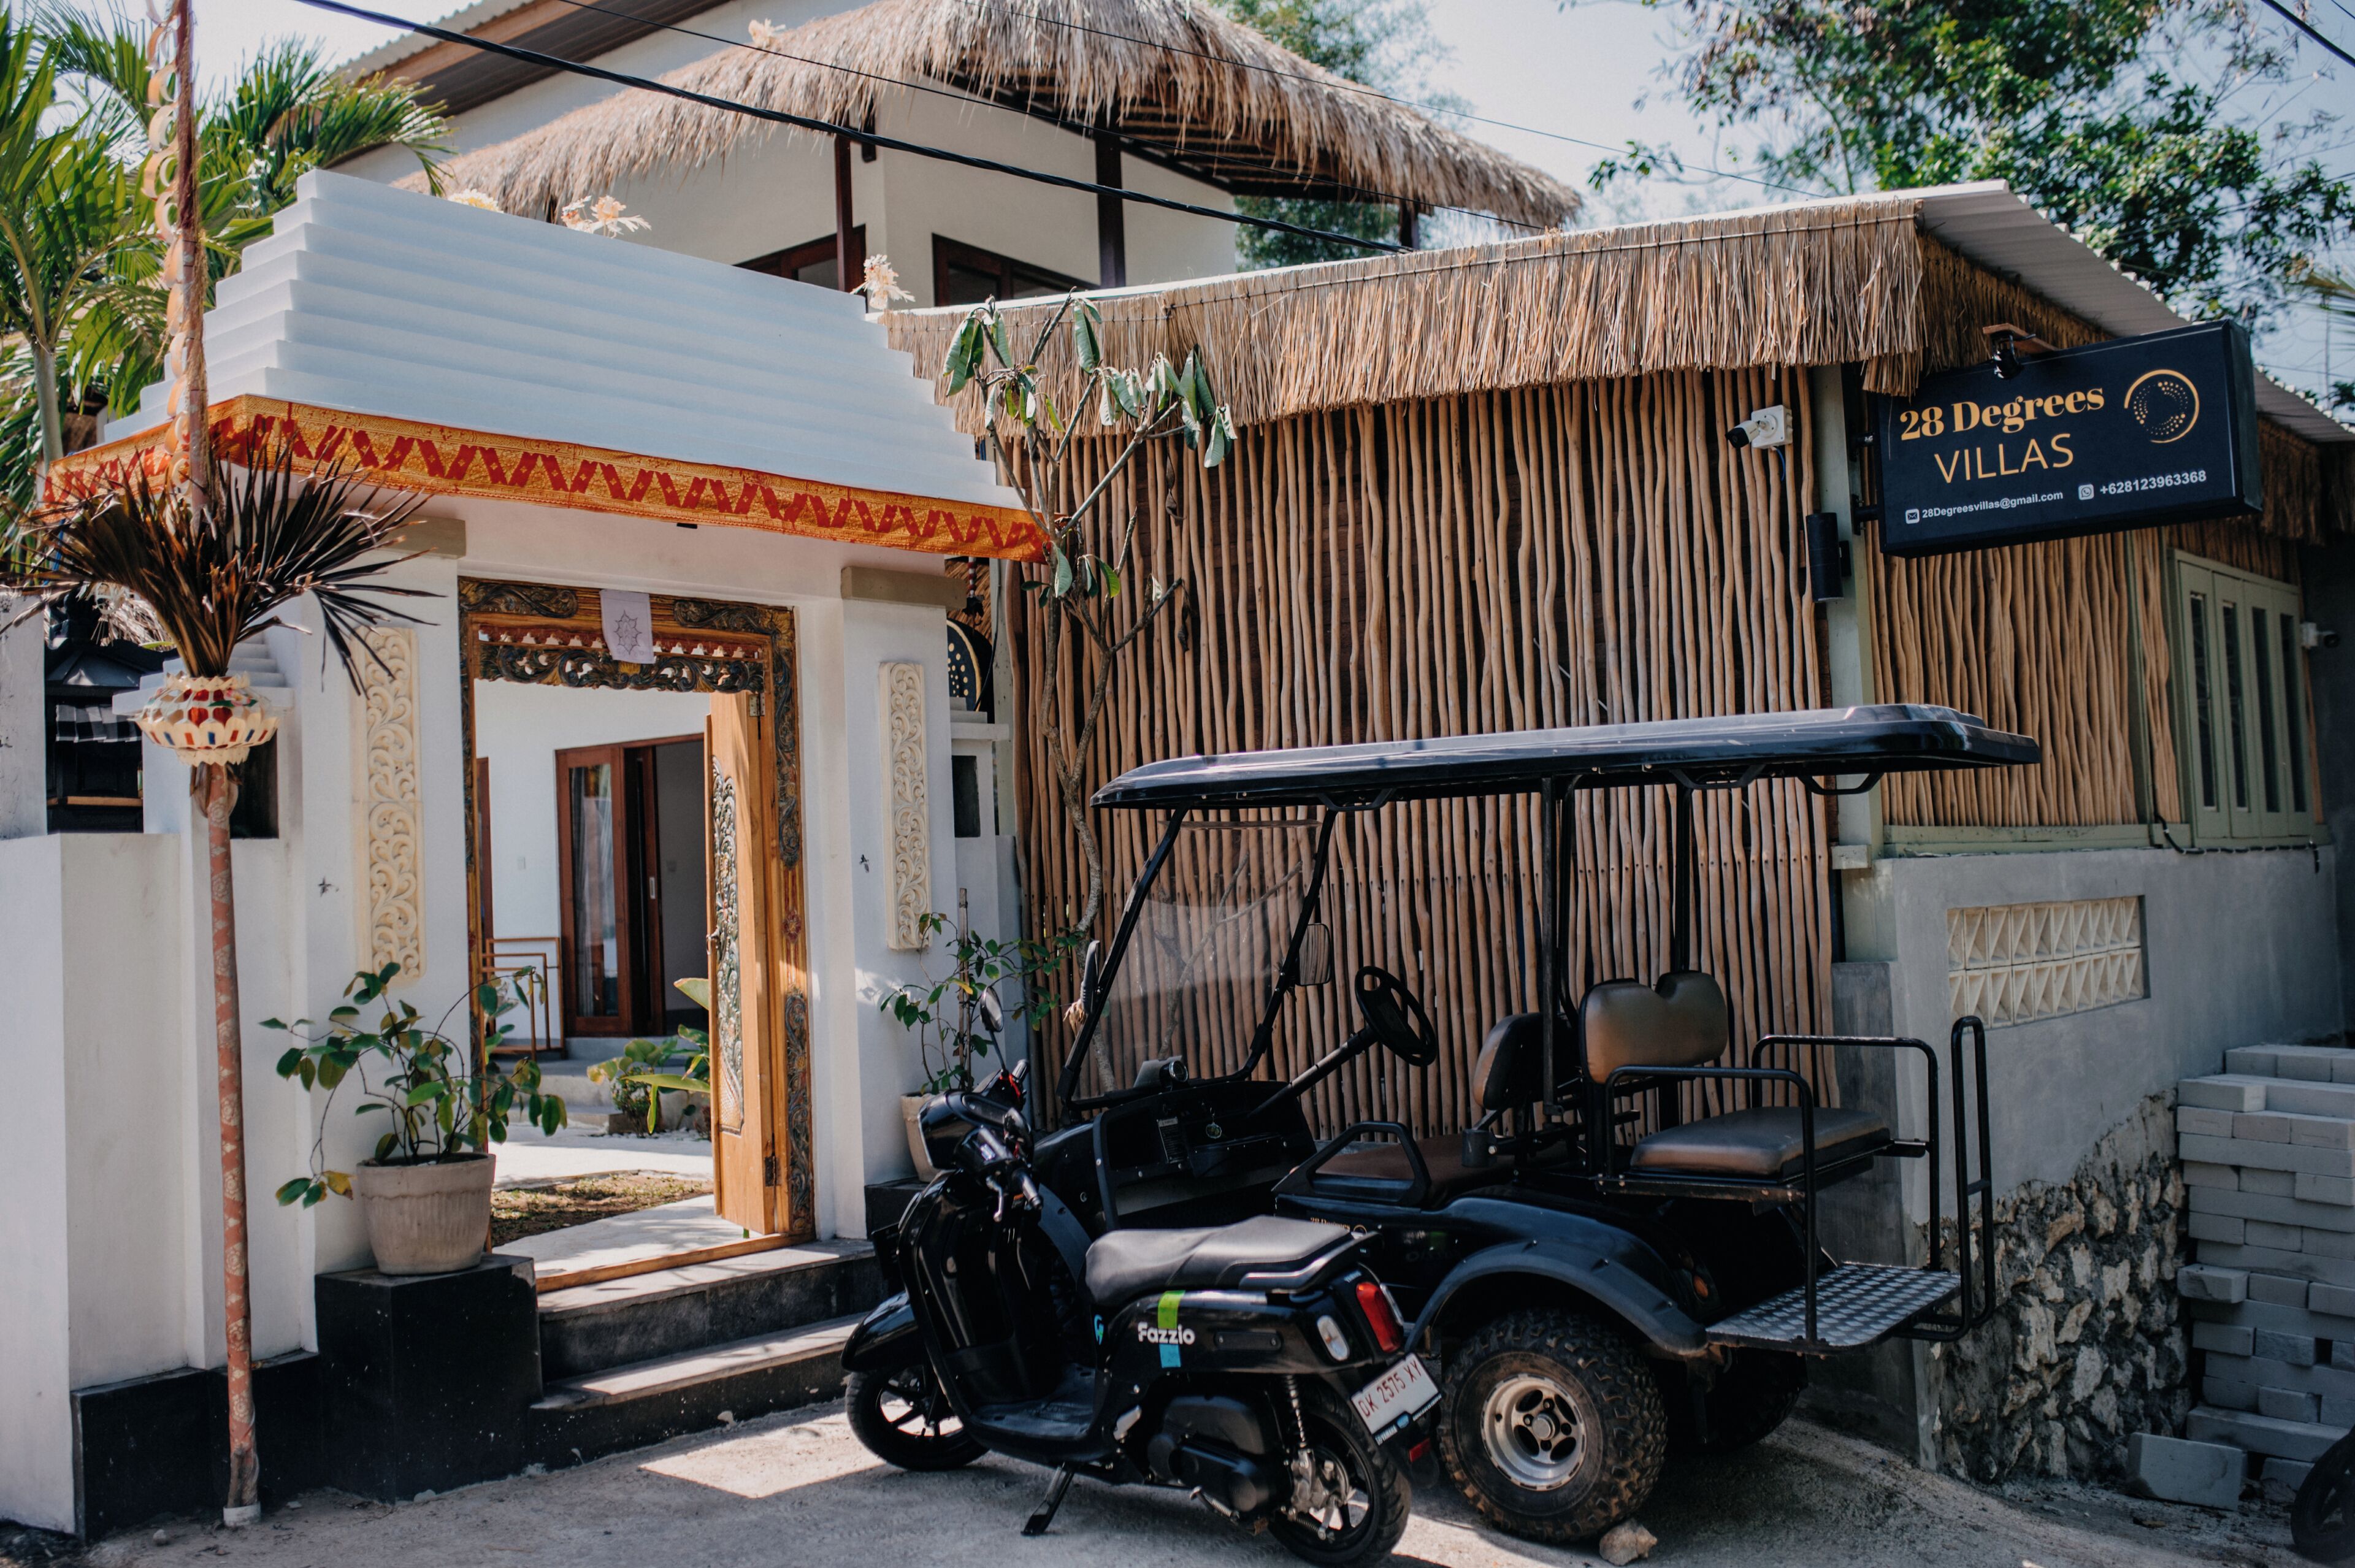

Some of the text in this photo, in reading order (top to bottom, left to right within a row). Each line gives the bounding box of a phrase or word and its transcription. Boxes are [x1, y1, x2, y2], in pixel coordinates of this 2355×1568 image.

[1899, 387, 2105, 441] 28 Degrees
[1934, 432, 2074, 484] VILLAS
[2100, 470, 2207, 495] +628123963368
[1922, 492, 2063, 518] 28Degreesvillas@gmail.com
[1138, 1321, 1195, 1345] Fazzio
[1358, 1360, 1422, 1417] DK 2575 XY
